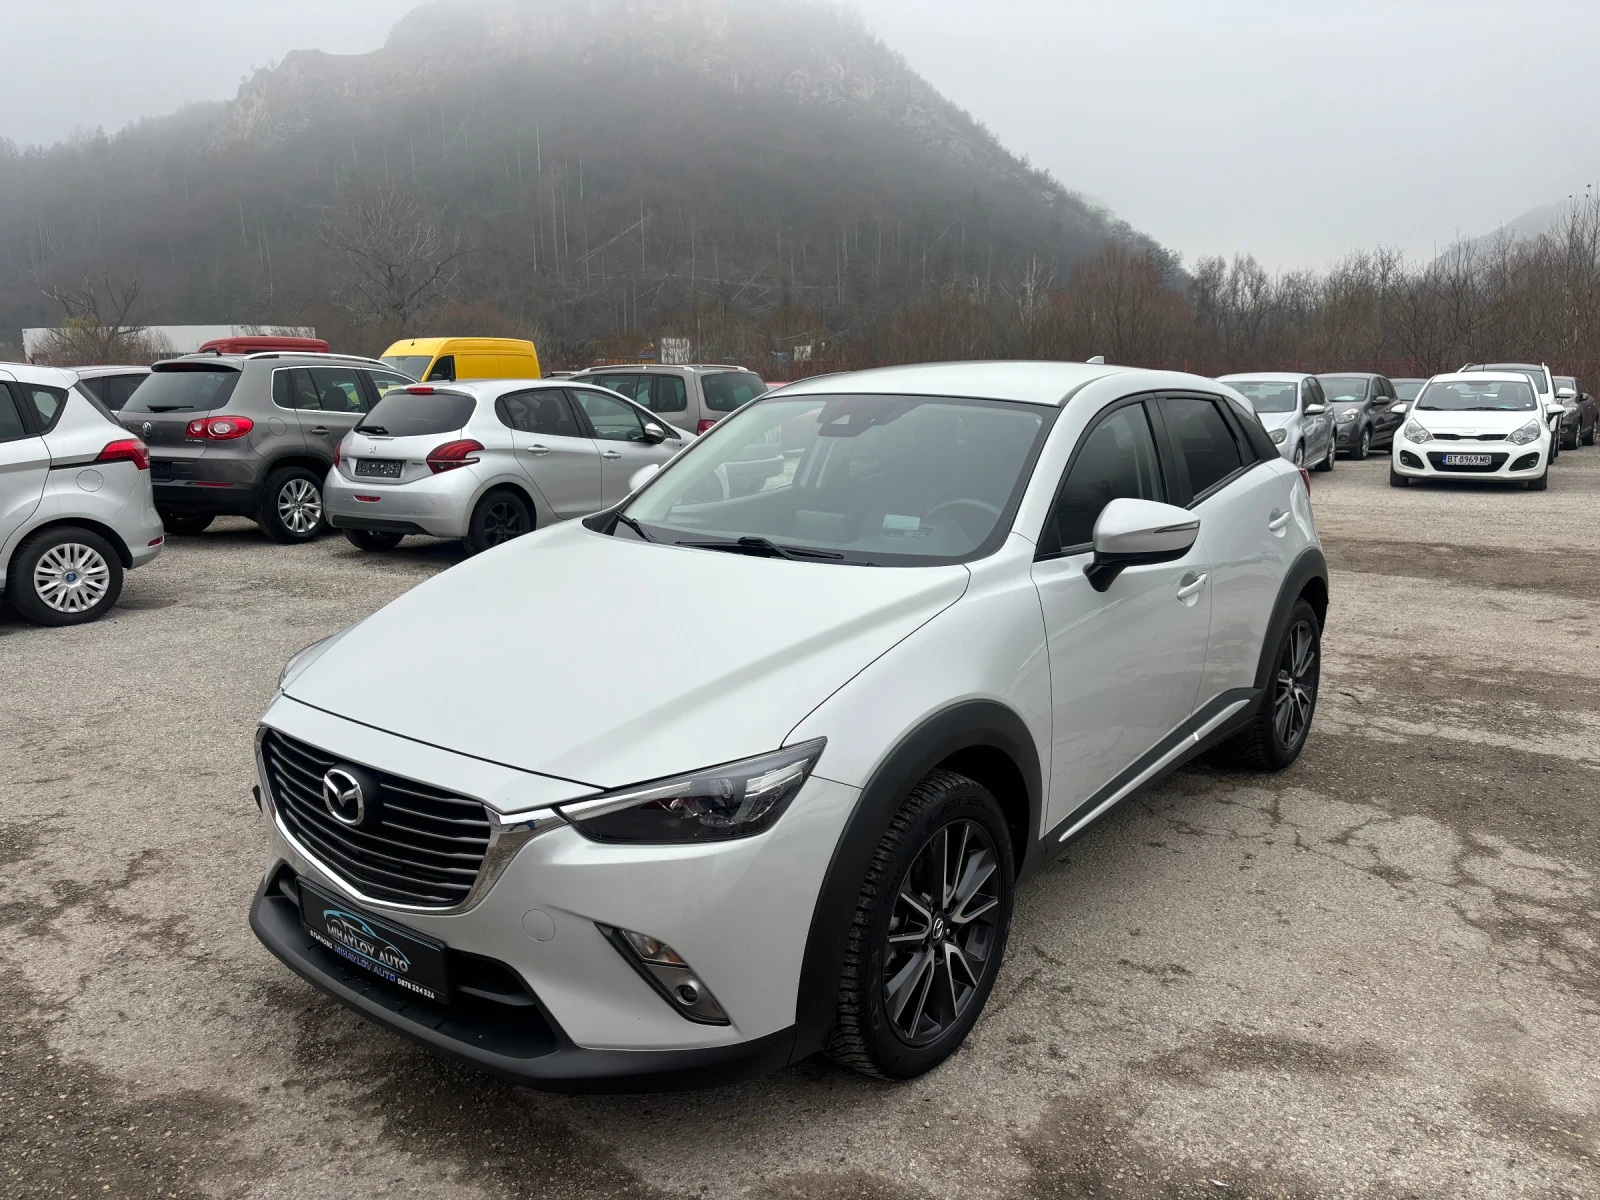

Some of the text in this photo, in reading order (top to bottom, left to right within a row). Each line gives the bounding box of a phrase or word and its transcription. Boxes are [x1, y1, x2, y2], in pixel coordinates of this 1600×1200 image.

[1447, 455, 1458, 463] BT
[1459, 455, 1479, 463] 8969
[327, 923, 409, 973] MIHAYLOV AUTO
[334, 944, 372, 971] MIHAYLOV
[373, 966, 396, 982] AUTO
[411, 984, 423, 994] 324
[423, 988, 435, 999] 326
